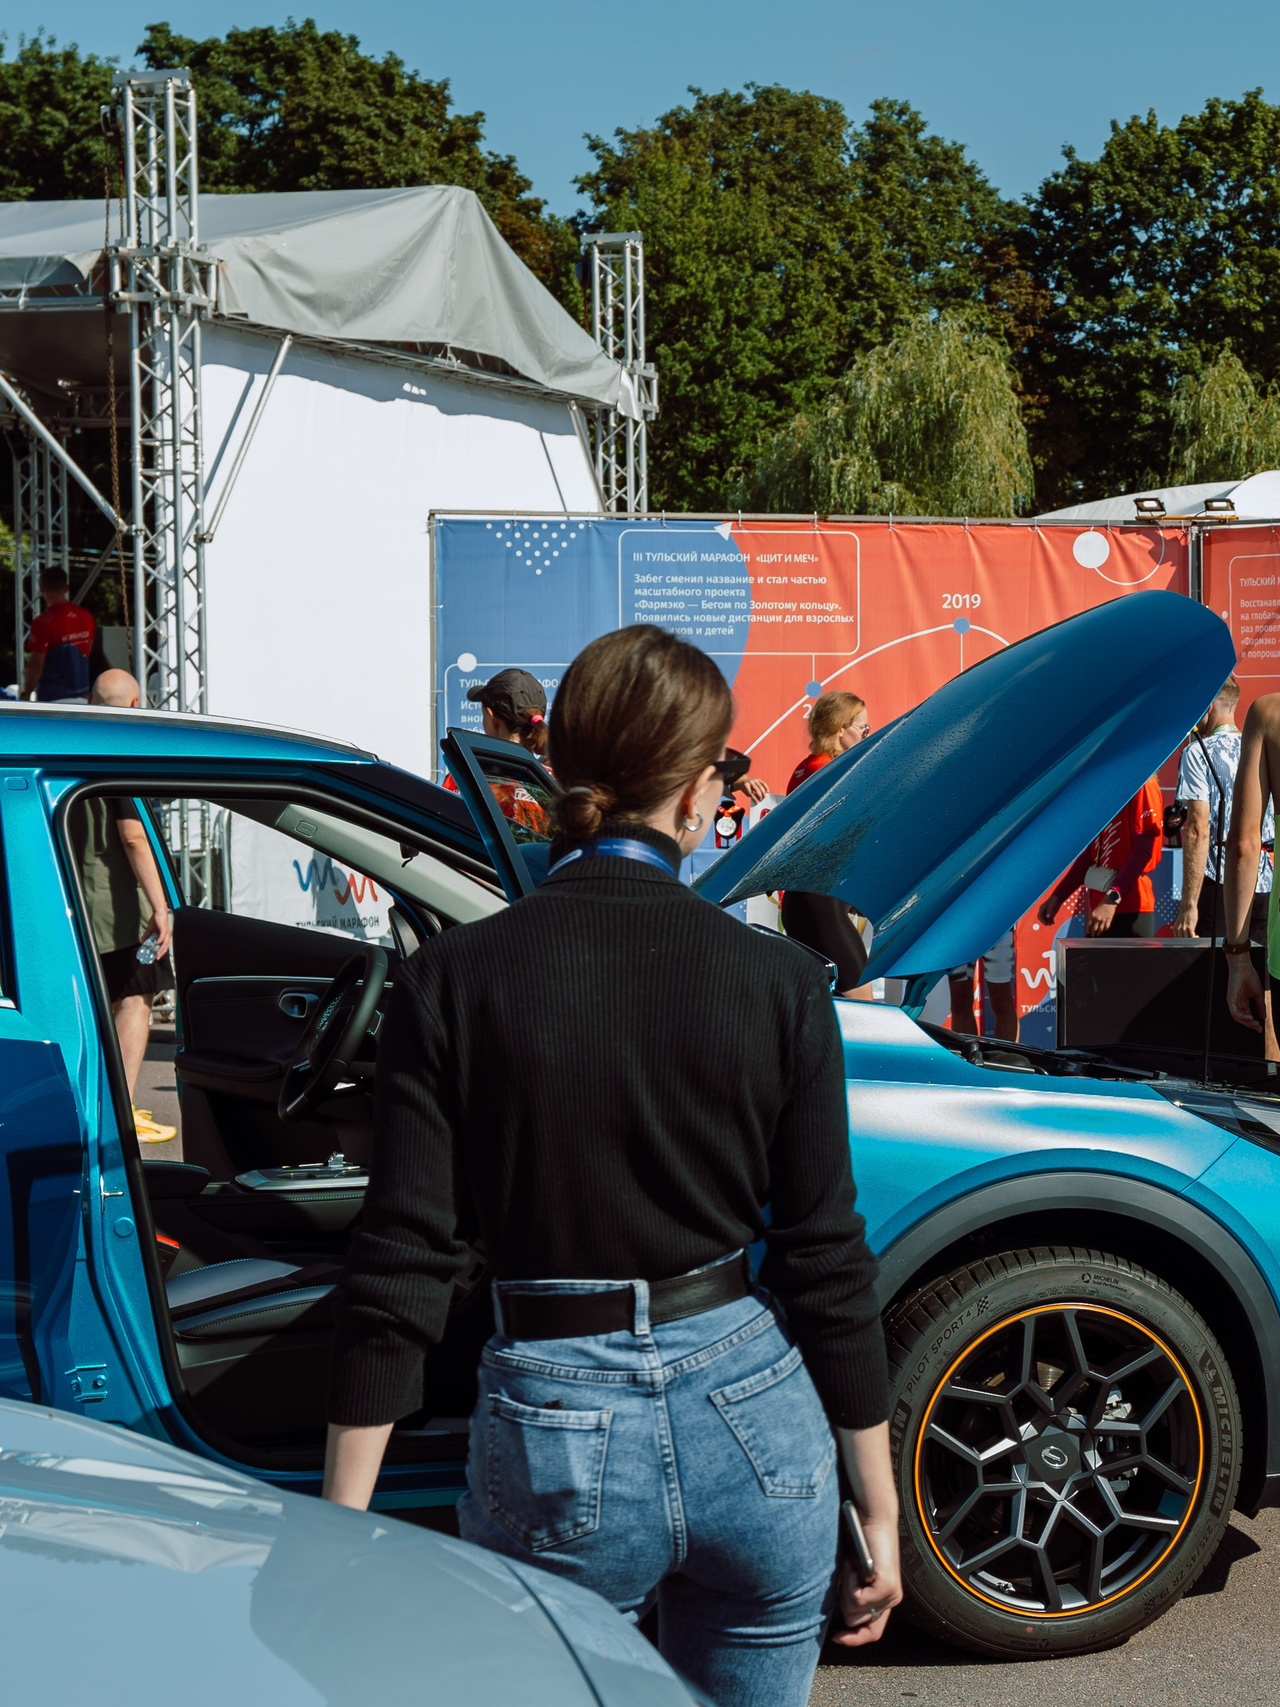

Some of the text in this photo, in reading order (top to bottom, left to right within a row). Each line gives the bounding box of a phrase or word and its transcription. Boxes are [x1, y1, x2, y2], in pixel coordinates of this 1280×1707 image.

[645, 551, 698, 562] ТУЛЬСКИЙ
[700, 553, 750, 562] МАРАФОН
[756, 554, 782, 564] «ЩИТ
[784, 554, 792, 562] И
[794, 554, 818, 563] МЕЧ»
[634, 574, 663, 584] Забег
[665, 576, 703, 584] сменил
[706, 576, 754, 584] название
[790, 576, 827, 585] частью
[1240, 575, 1276, 587] ТУЛЬСКИЙ
[634, 587, 746, 599] масштабного проекта
[634, 600, 685, 611] «Фармэко
[702, 600, 732, 610] Бегом
[734, 602, 747, 610] по
[750, 600, 797, 612] Золотому
[800, 602, 842, 612] кольцу».
[941, 593, 981, 610] 2019
[634, 612, 854, 624] Появились новые дистанции для взрослых
[696, 626, 702, 634] и
[704, 625, 734, 636] детей
[1241, 626, 1253, 634] раз
[340, 916, 380, 929] МАРАФОН
[1020, 1004, 1056, 1012] ТУЛЬСК
[906, 1353, 930, 1394] PILOT
[931, 1315, 964, 1354] SPORT
[1212, 1386, 1232, 1514] MICHELIN
